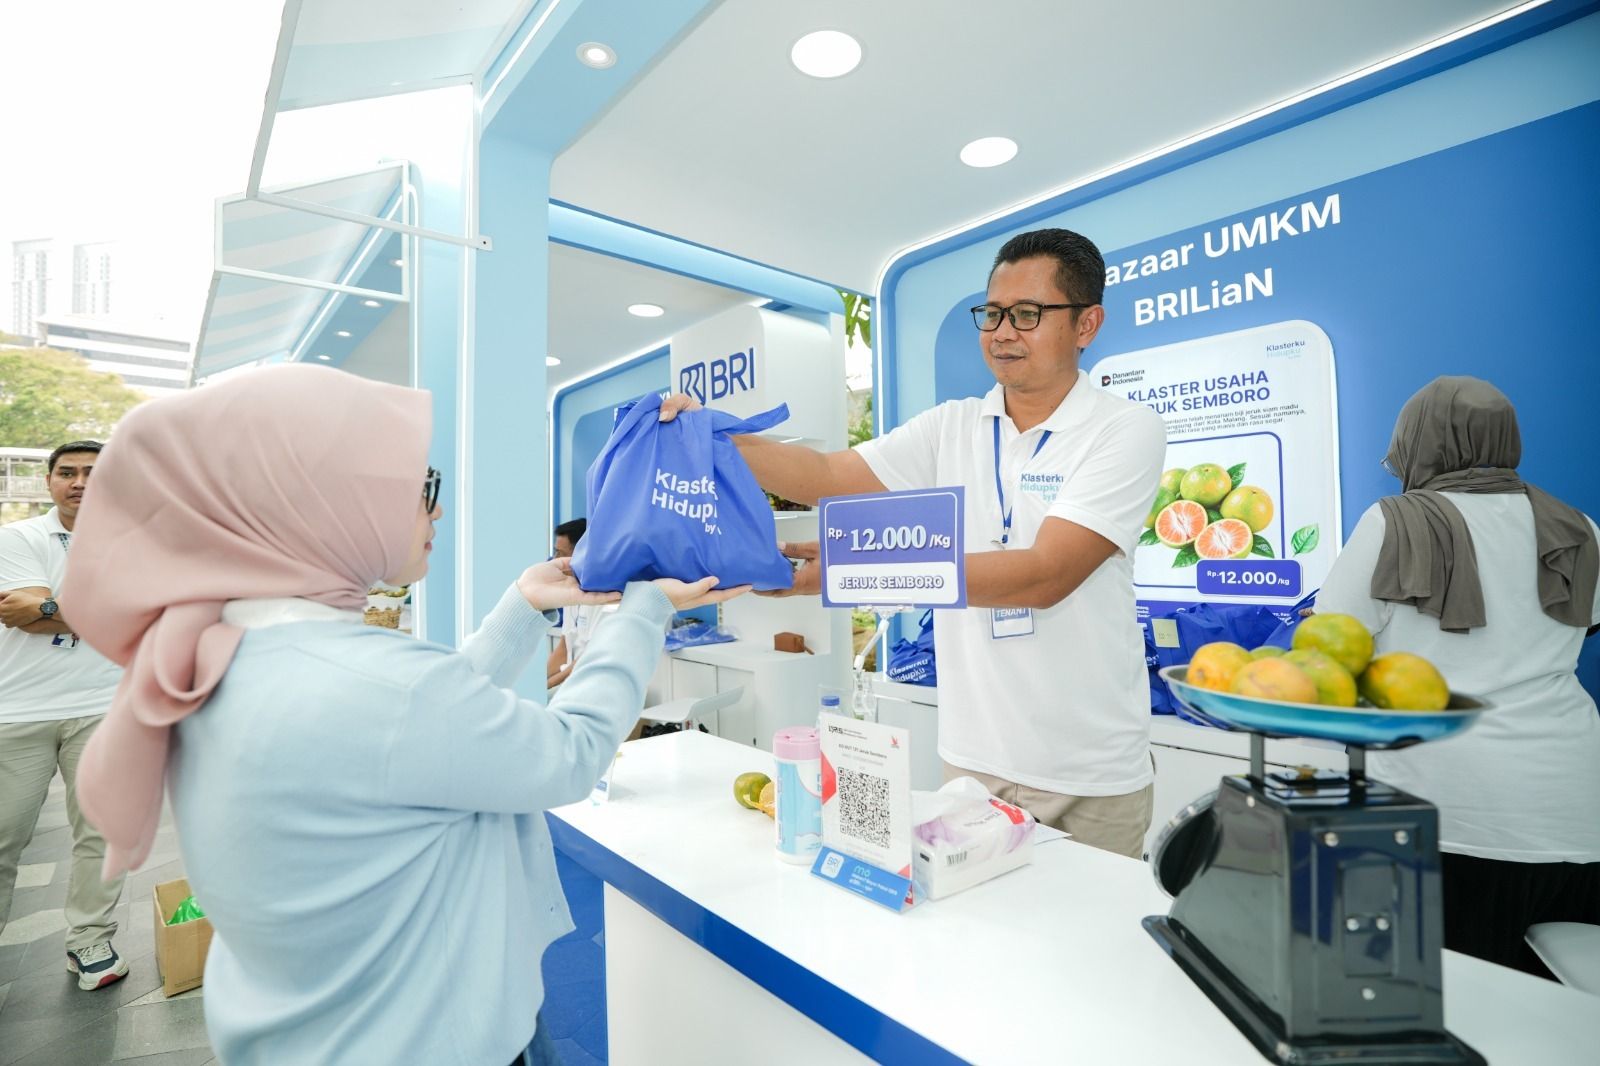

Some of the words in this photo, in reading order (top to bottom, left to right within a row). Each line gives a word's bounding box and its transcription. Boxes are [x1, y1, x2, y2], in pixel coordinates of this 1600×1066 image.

[1105, 243, 1194, 286] azaar
[1204, 193, 1341, 258] UMKM
[1134, 267, 1273, 326] BRILiaN
[1266, 340, 1305, 351] Klasterku
[711, 347, 755, 400] BRI
[1112, 369, 1145, 379] Danantara
[1112, 376, 1143, 385] Indonesia
[1128, 381, 1200, 402] KLASTER
[1204, 370, 1269, 392] USAHA
[1182, 387, 1271, 411] SEMBORO
[656, 468, 718, 500] Klaste
[1021, 473, 1063, 482] Klasterk
[652, 488, 717, 523] Hidup
[705, 523, 716, 534] by
[828, 528, 847, 539] Rp.
[851, 525, 927, 551] 12.000
[930, 534, 951, 548] /Kg
[839, 576, 878, 589] JERUK
[880, 575, 944, 589] SEMBORO
[1219, 571, 1277, 585] 12.000
[1278, 577, 1290, 585] /kg
